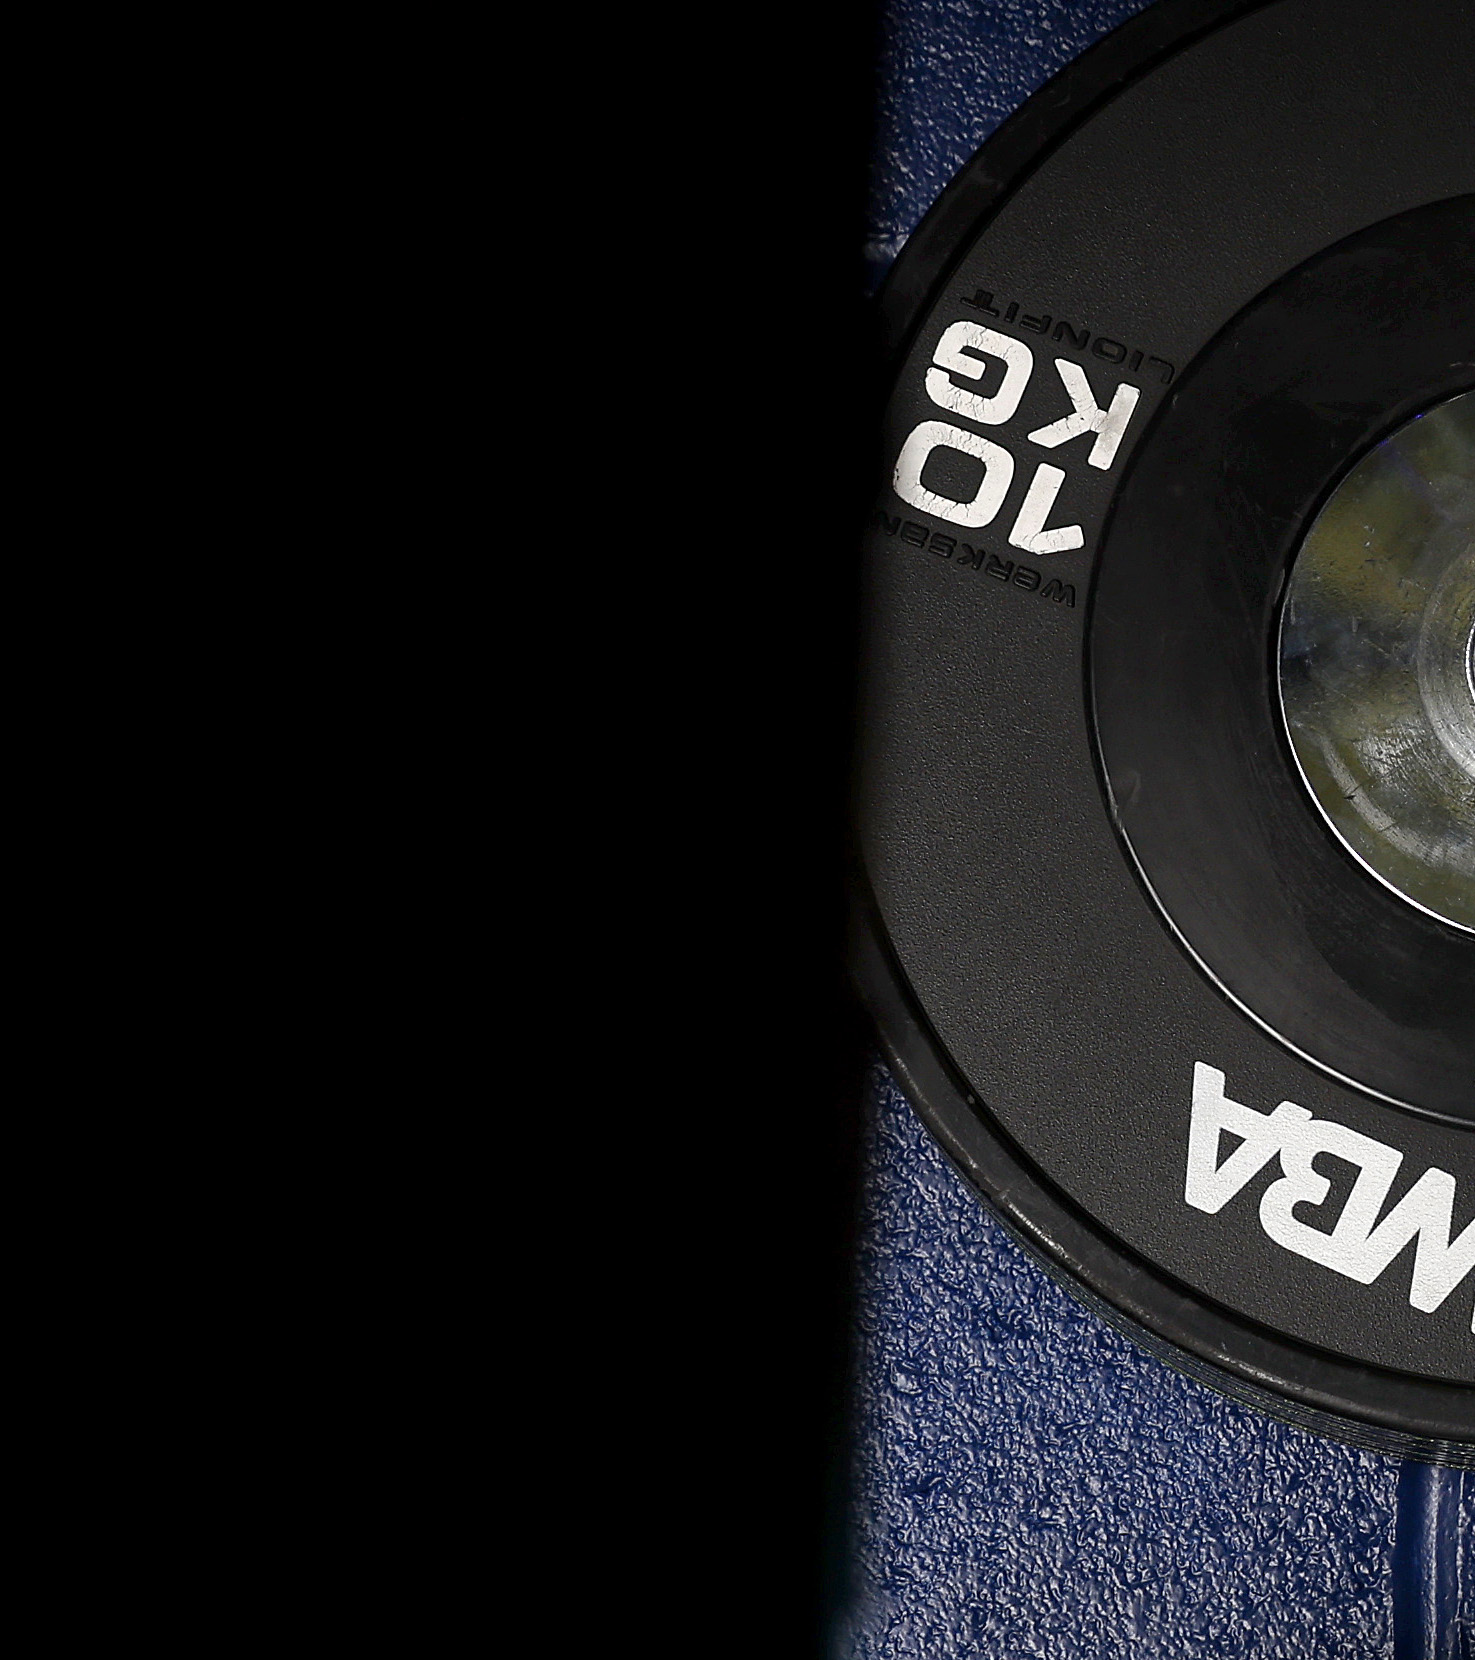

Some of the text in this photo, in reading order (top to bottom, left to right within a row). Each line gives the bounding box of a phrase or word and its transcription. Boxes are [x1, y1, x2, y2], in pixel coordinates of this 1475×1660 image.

[924, 320, 1141, 471] KG
[960, 288, 1176, 386] LIONFIT
[893, 419, 1085, 555] 10
